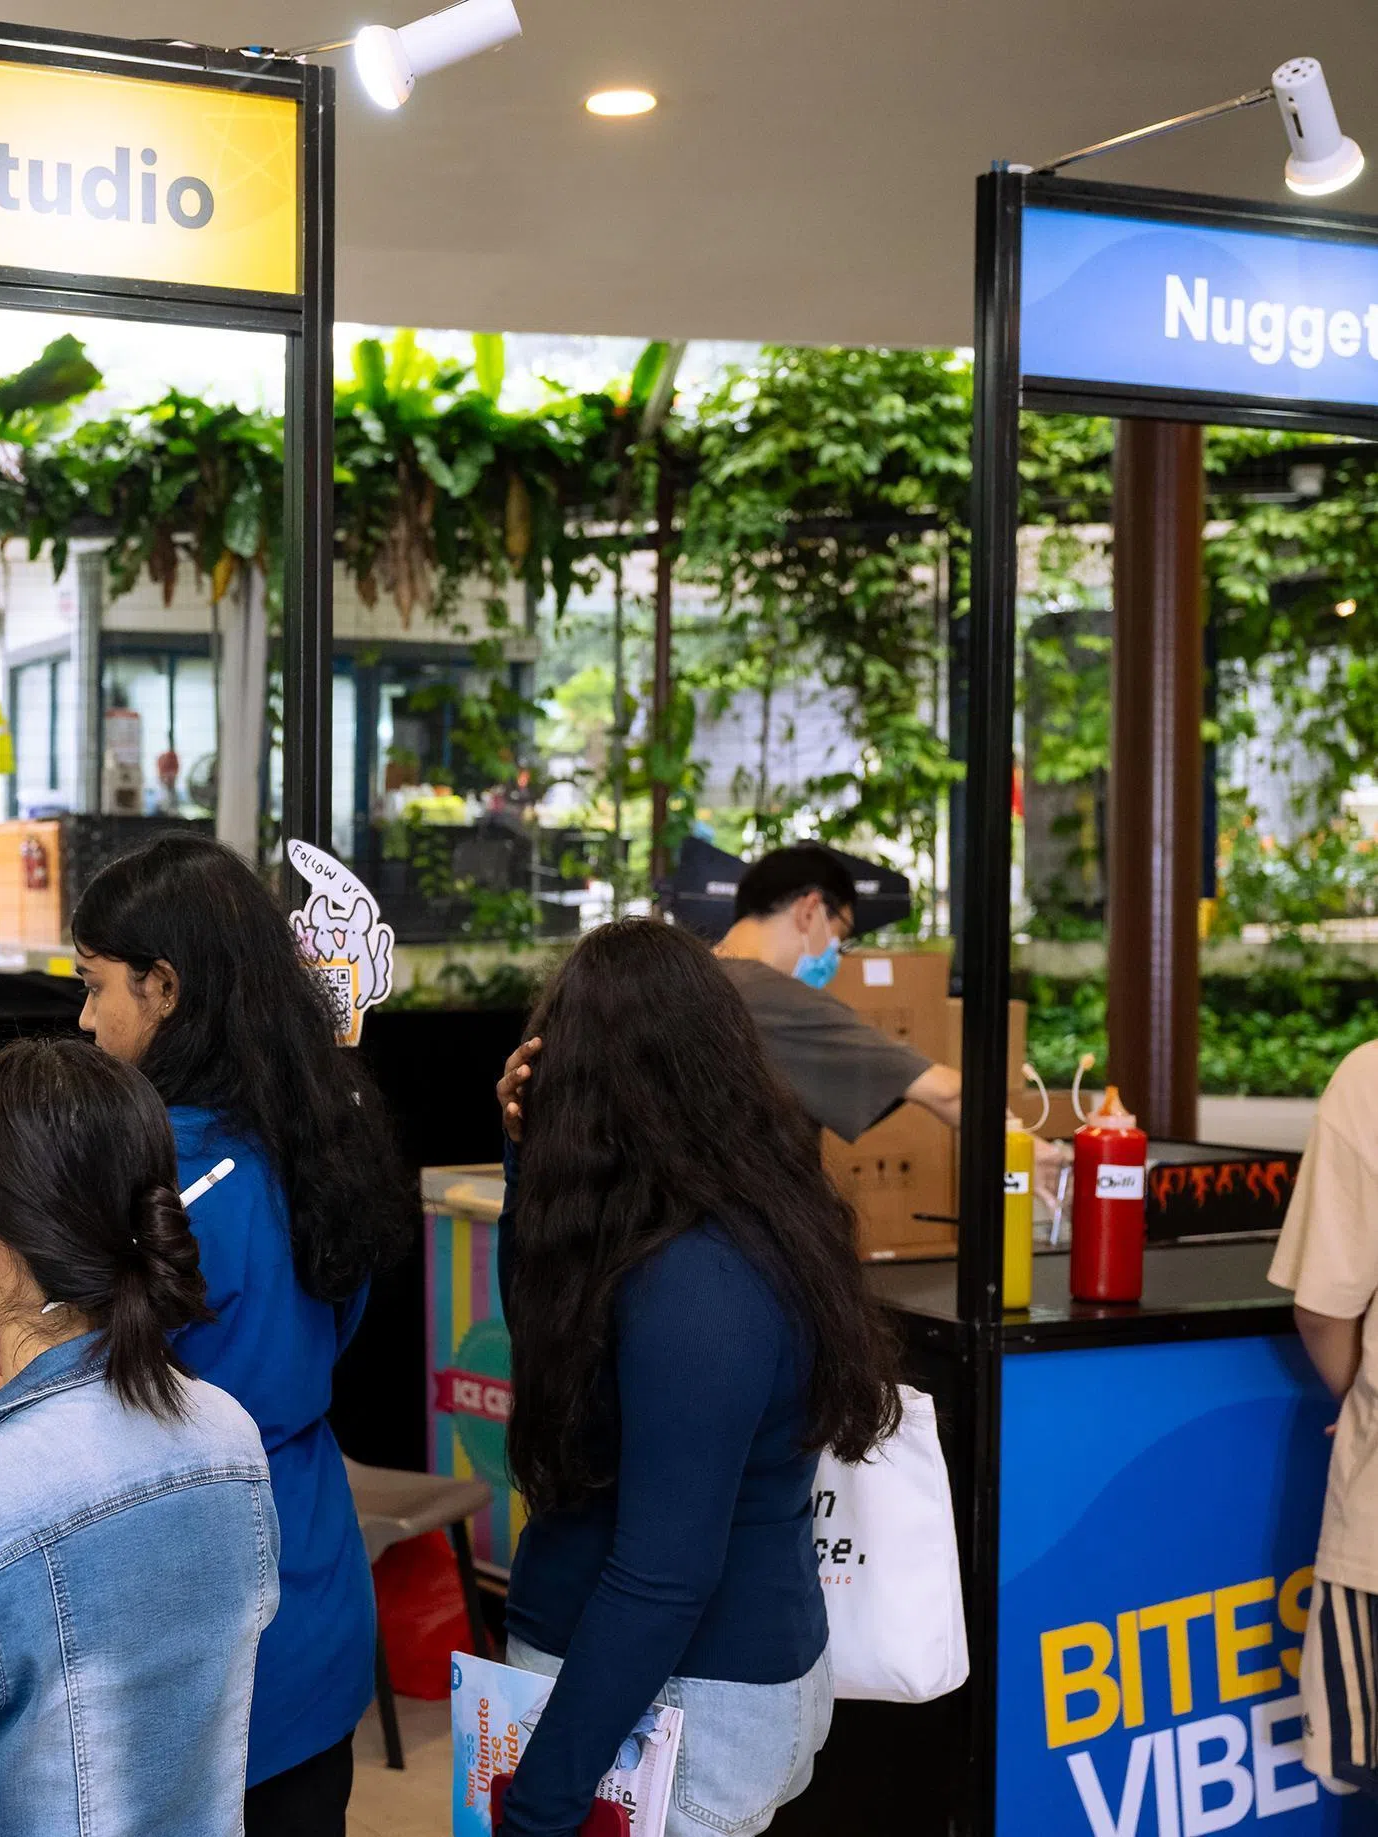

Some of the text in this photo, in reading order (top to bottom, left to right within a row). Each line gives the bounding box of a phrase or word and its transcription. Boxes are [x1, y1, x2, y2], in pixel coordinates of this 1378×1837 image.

[477, 1697, 490, 1793] Ultimate
[1066, 1690, 1359, 1837] VIBE
[465, 1769, 476, 1808] Your
[598, 1777, 606, 1799] now
